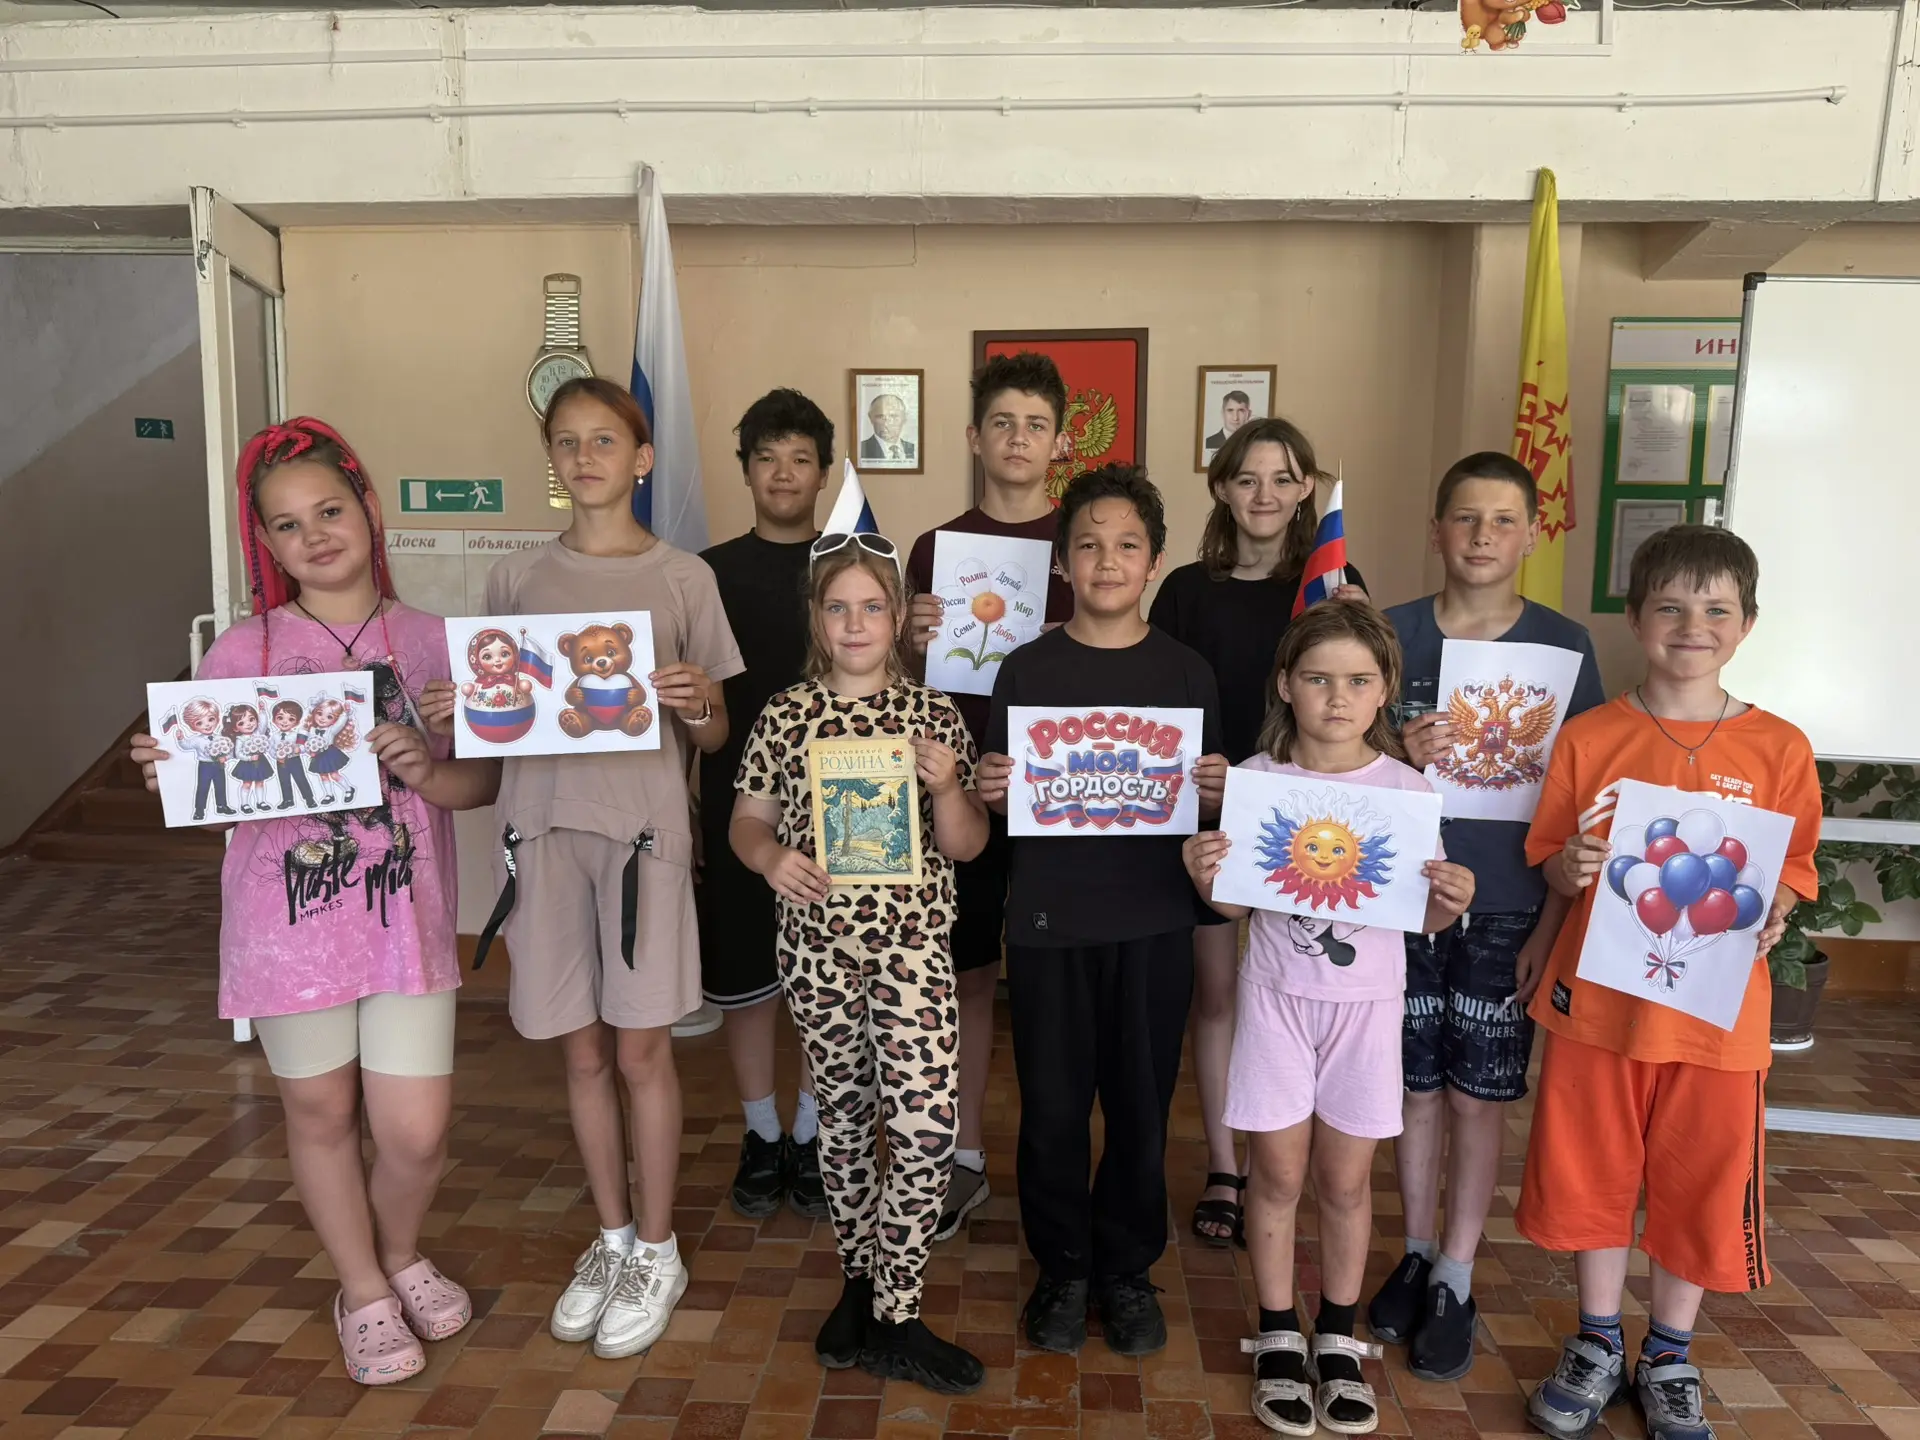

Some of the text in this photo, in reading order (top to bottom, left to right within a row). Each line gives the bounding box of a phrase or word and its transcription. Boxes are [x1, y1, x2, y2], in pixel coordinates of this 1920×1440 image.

[389, 533, 437, 551] Доска
[959, 571, 988, 586] Родина
[995, 571, 1022, 592] Дружба
[941, 596, 966, 609] Россия
[1013, 601, 1034, 617] Мир
[953, 620, 977, 638] Семья
[991, 623, 1017, 643] Добро
[1027, 711, 1184, 760] РОССИЯ
[819, 755, 885, 771] РОДИНА
[1067, 750, 1140, 775] МОЯ
[1034, 774, 1185, 804] ГОРДОСТЬ!
[300, 899, 343, 921] MAKES
[1743, 1219, 1756, 1277] GAMER
